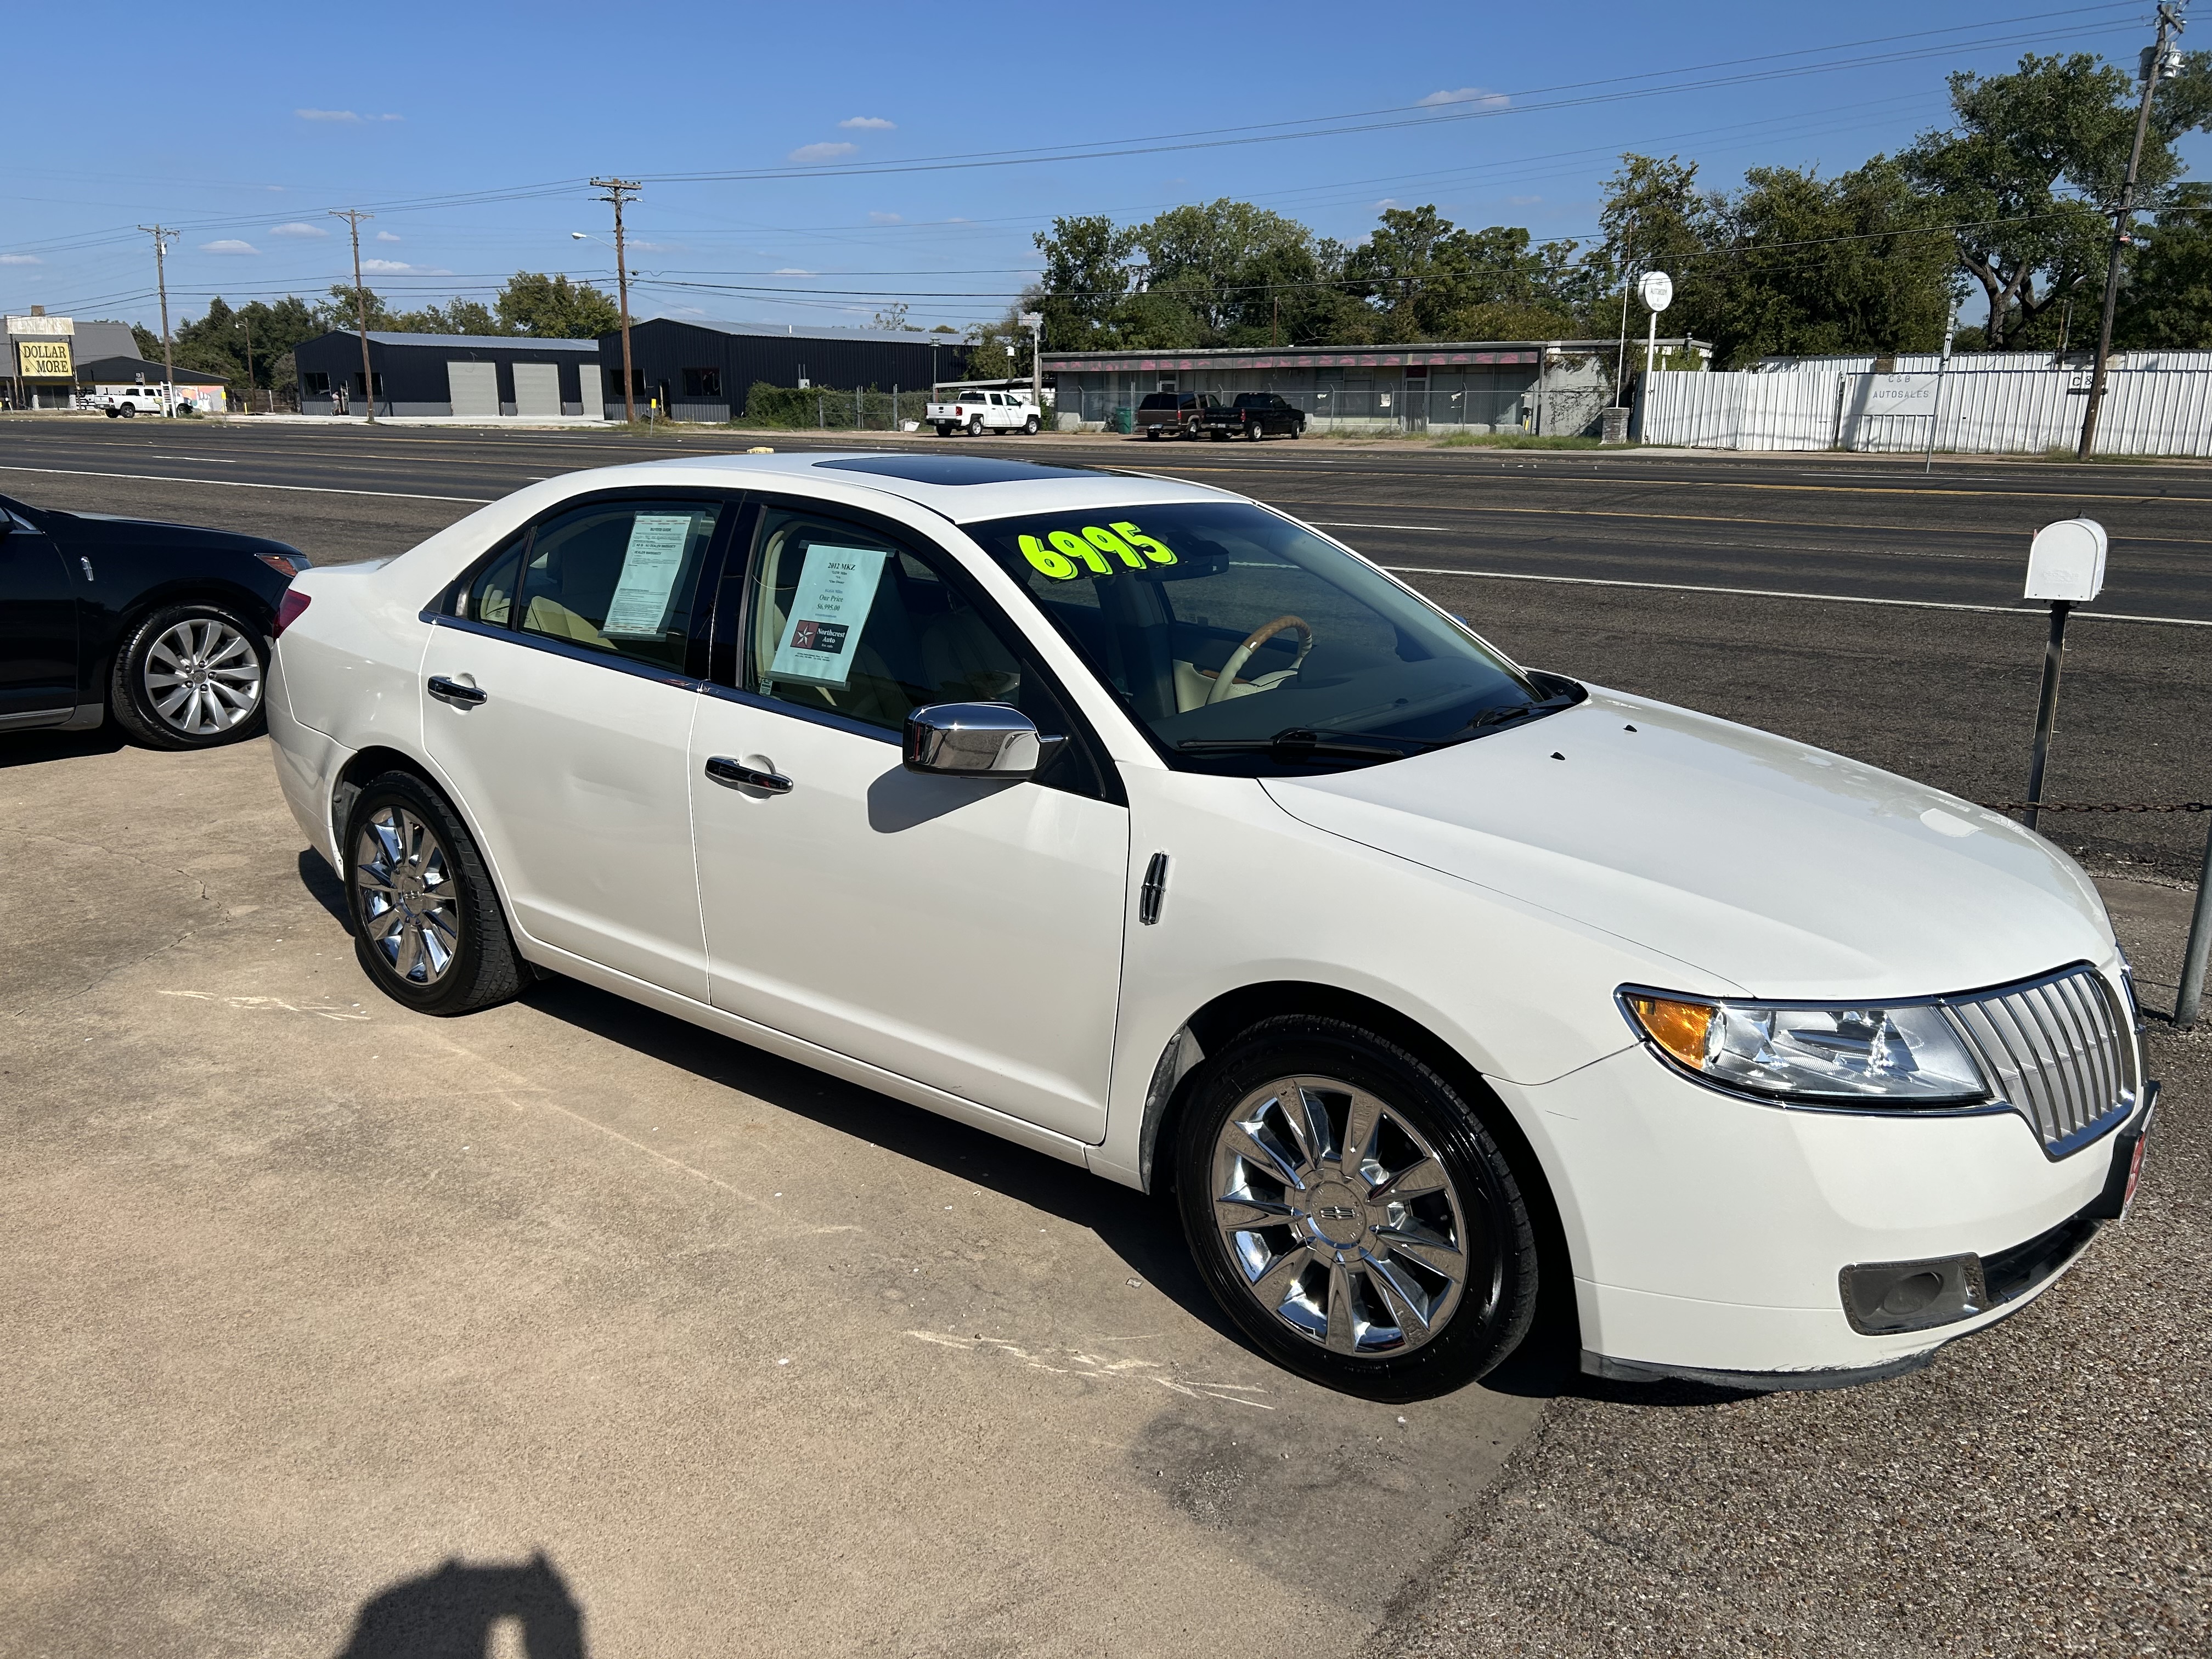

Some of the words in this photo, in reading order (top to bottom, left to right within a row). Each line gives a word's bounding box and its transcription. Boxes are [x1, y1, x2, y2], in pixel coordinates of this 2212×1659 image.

[22, 346, 66, 358] DOLLAR
[36, 360, 69, 373] MORE
[2073, 377, 2081, 386] C
[1872, 390, 1929, 398] AUTOSALES
[1017, 521, 1179, 580] 6995
[841, 563, 856, 571] MKZ
[816, 628, 845, 638] Northcrest
